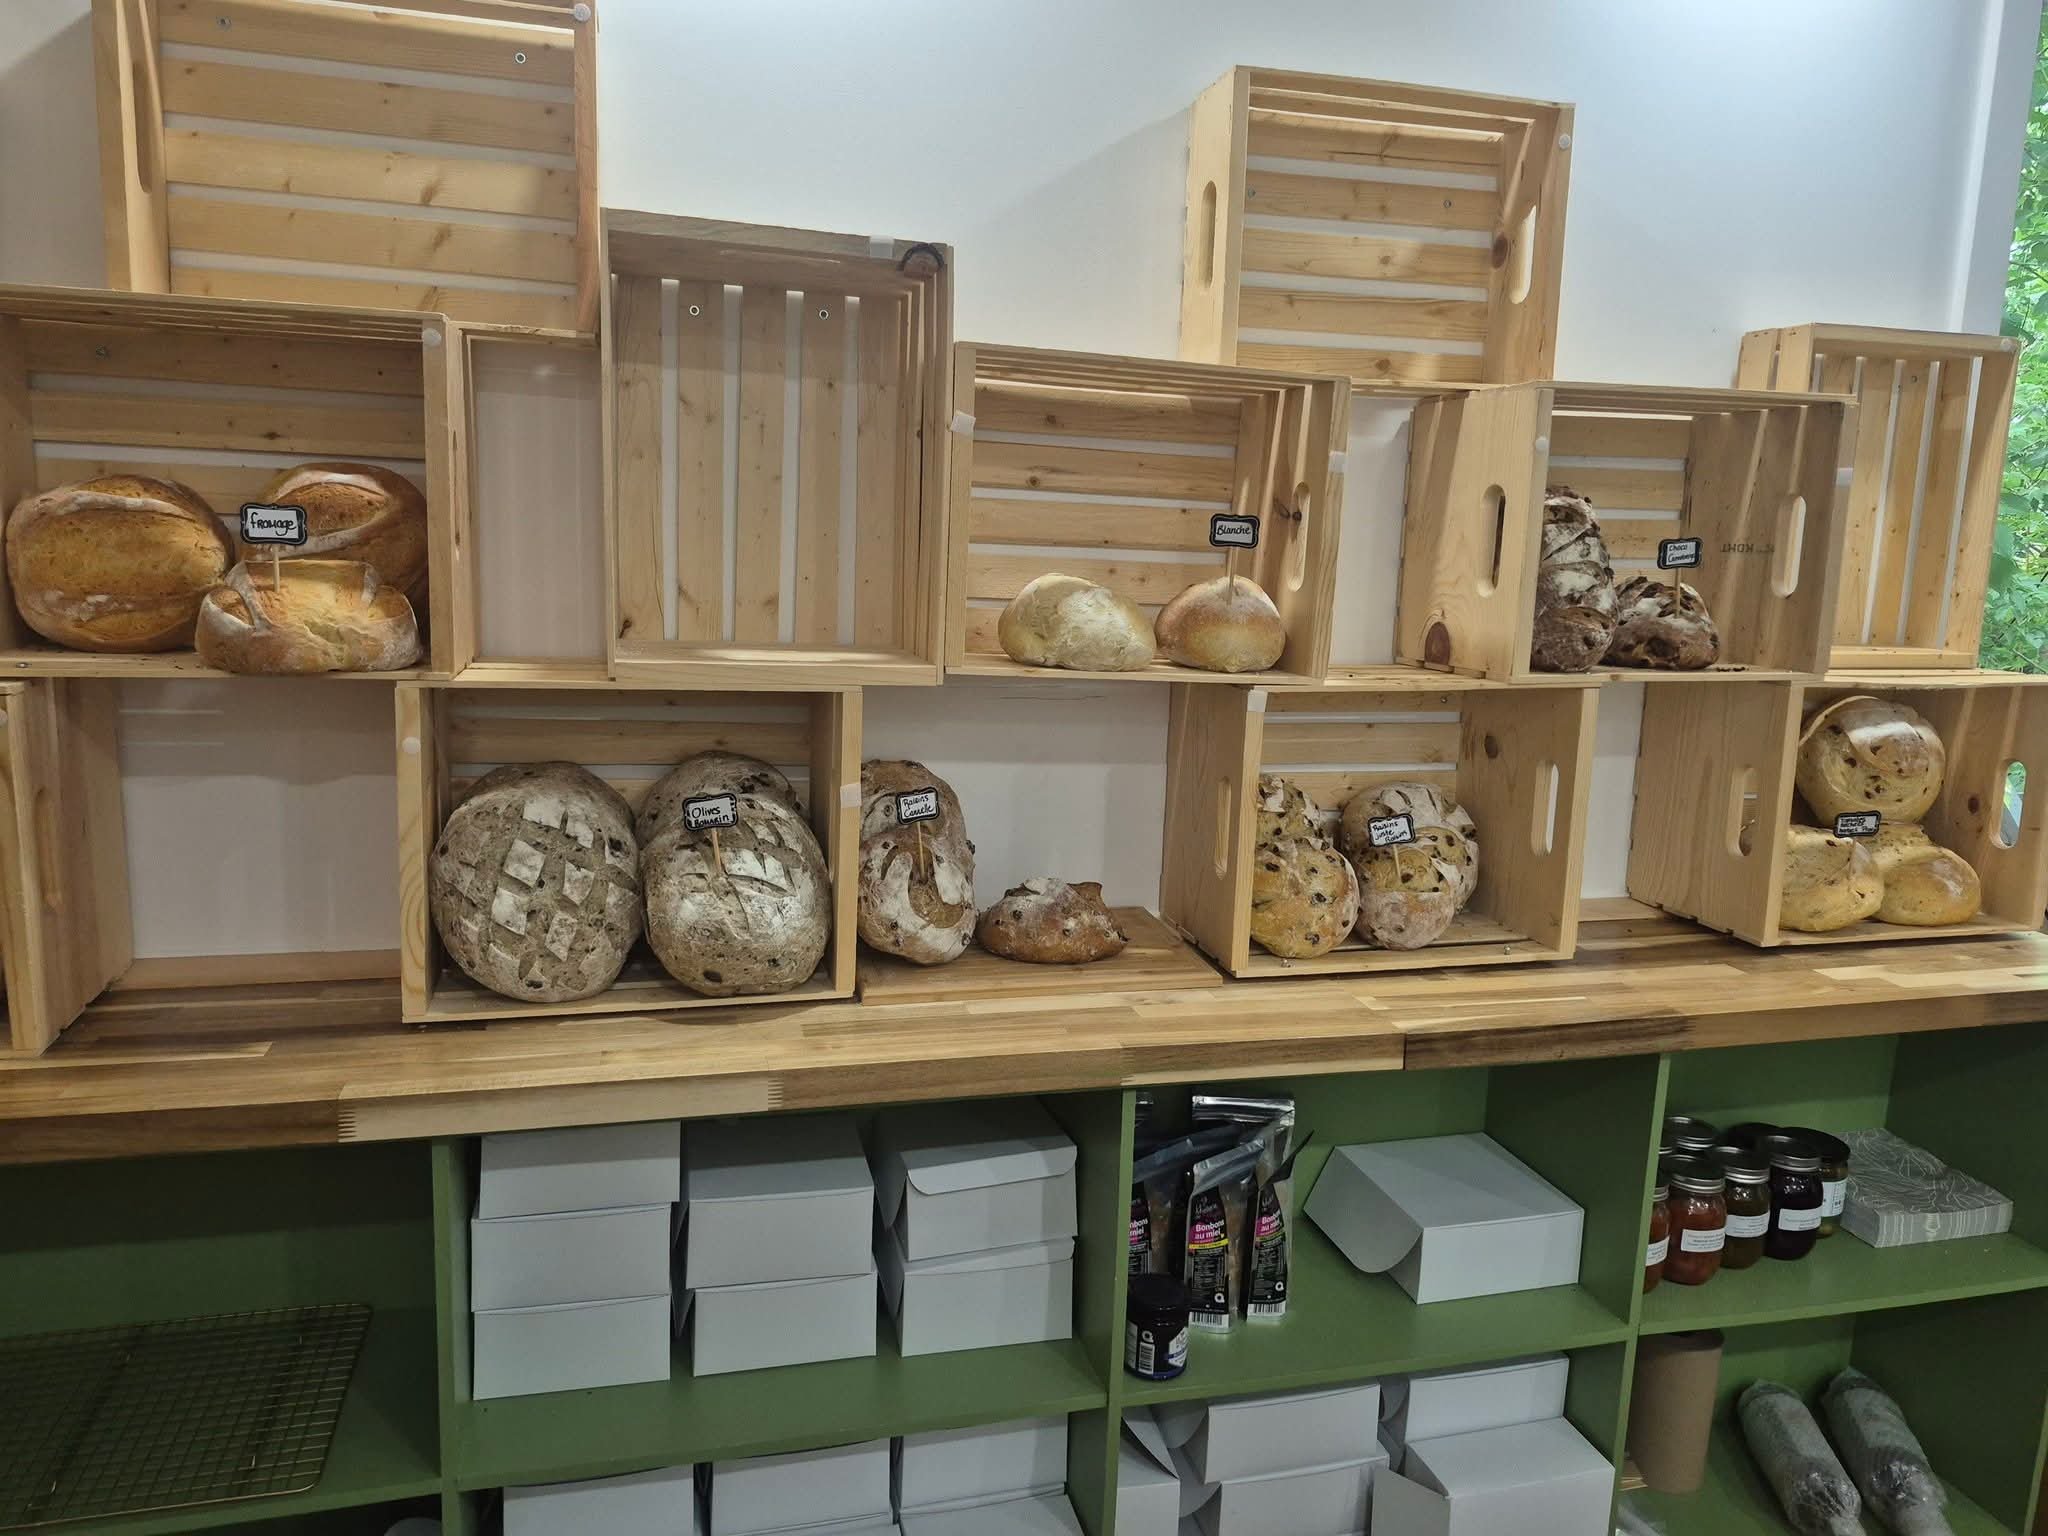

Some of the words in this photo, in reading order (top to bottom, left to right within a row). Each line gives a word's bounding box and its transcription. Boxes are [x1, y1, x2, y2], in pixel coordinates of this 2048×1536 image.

[1216, 525, 1251, 536] Blanche
[692, 806, 720, 819] Olives
[1195, 1220, 1225, 1232] Bonbons
[1205, 1228, 1221, 1238] miel
